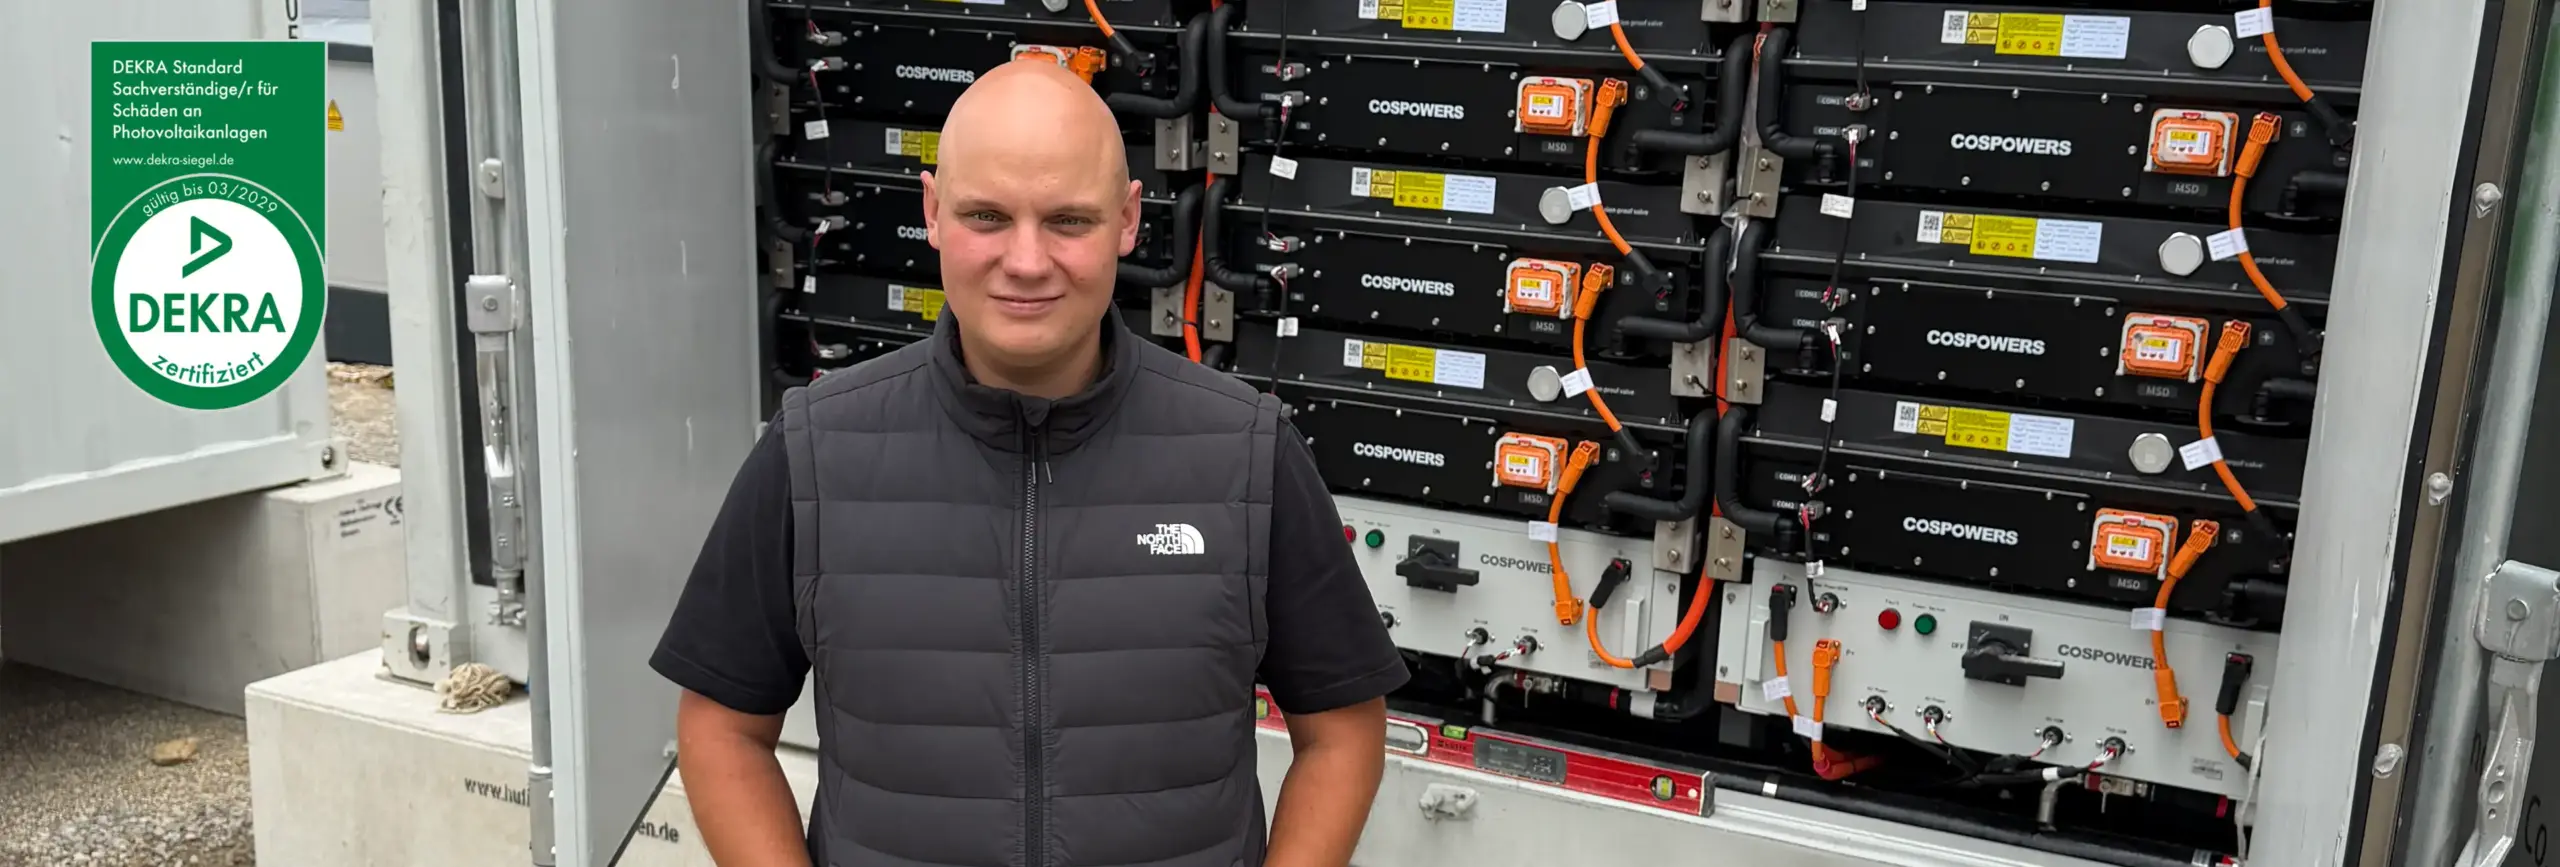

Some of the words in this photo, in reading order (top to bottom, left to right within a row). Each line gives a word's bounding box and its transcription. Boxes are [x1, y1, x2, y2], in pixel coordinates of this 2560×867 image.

[895, 64, 975, 84] COSPOWERS
[1367, 98, 1465, 120] COSPOWERS
[1547, 141, 1568, 152] MSD
[1950, 132, 2072, 156] COSPOWERS
[2174, 182, 2200, 195] MSD
[1360, 273, 1456, 297] COSPOWERS
[1535, 320, 1556, 332] MSD
[1926, 329, 2046, 356] COSPOWERS
[2145, 384, 2171, 398] MSD
[1352, 441, 1446, 468] COSPOWERS
[1523, 493, 1544, 504] MSD
[1155, 523, 1181, 534] THE
[1902, 516, 2020, 546] COSPOWERS
[1136, 533, 1181, 545] NORTH
[1150, 544, 1182, 555] FACE
[1480, 553, 1556, 576] COSPOWER
[2116, 577, 2142, 590] MSD
[2056, 643, 2160, 672] COSPOWER
